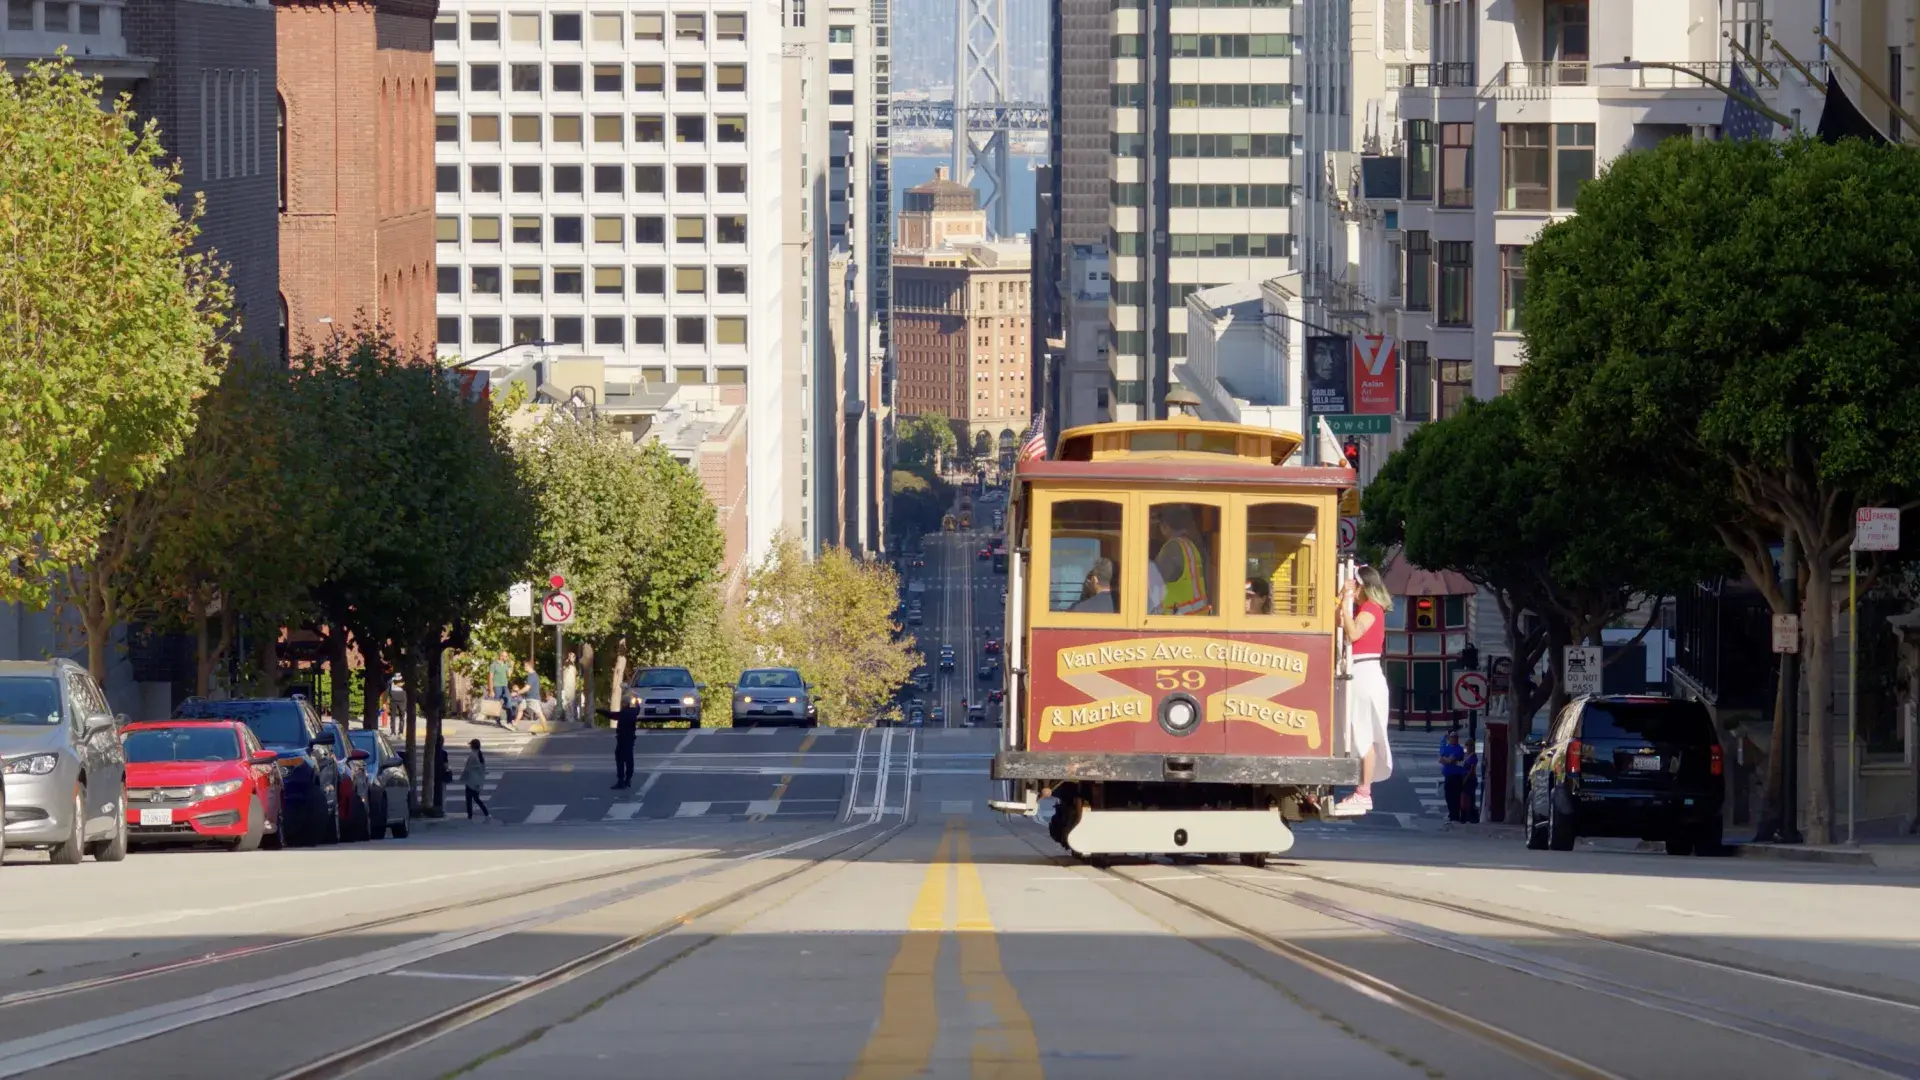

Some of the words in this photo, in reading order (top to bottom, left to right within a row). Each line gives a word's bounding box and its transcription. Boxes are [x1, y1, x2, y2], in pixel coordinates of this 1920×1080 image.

[1859, 509, 1871, 521] NO
[1061, 651, 1097, 669] Van
[1098, 645, 1148, 665] Ness
[1204, 642, 1305, 673] California
[1155, 669, 1206, 690] 59
[1051, 709, 1066, 726] &
[1070, 700, 1143, 725] Market
[1223, 698, 1308, 729] Streets
